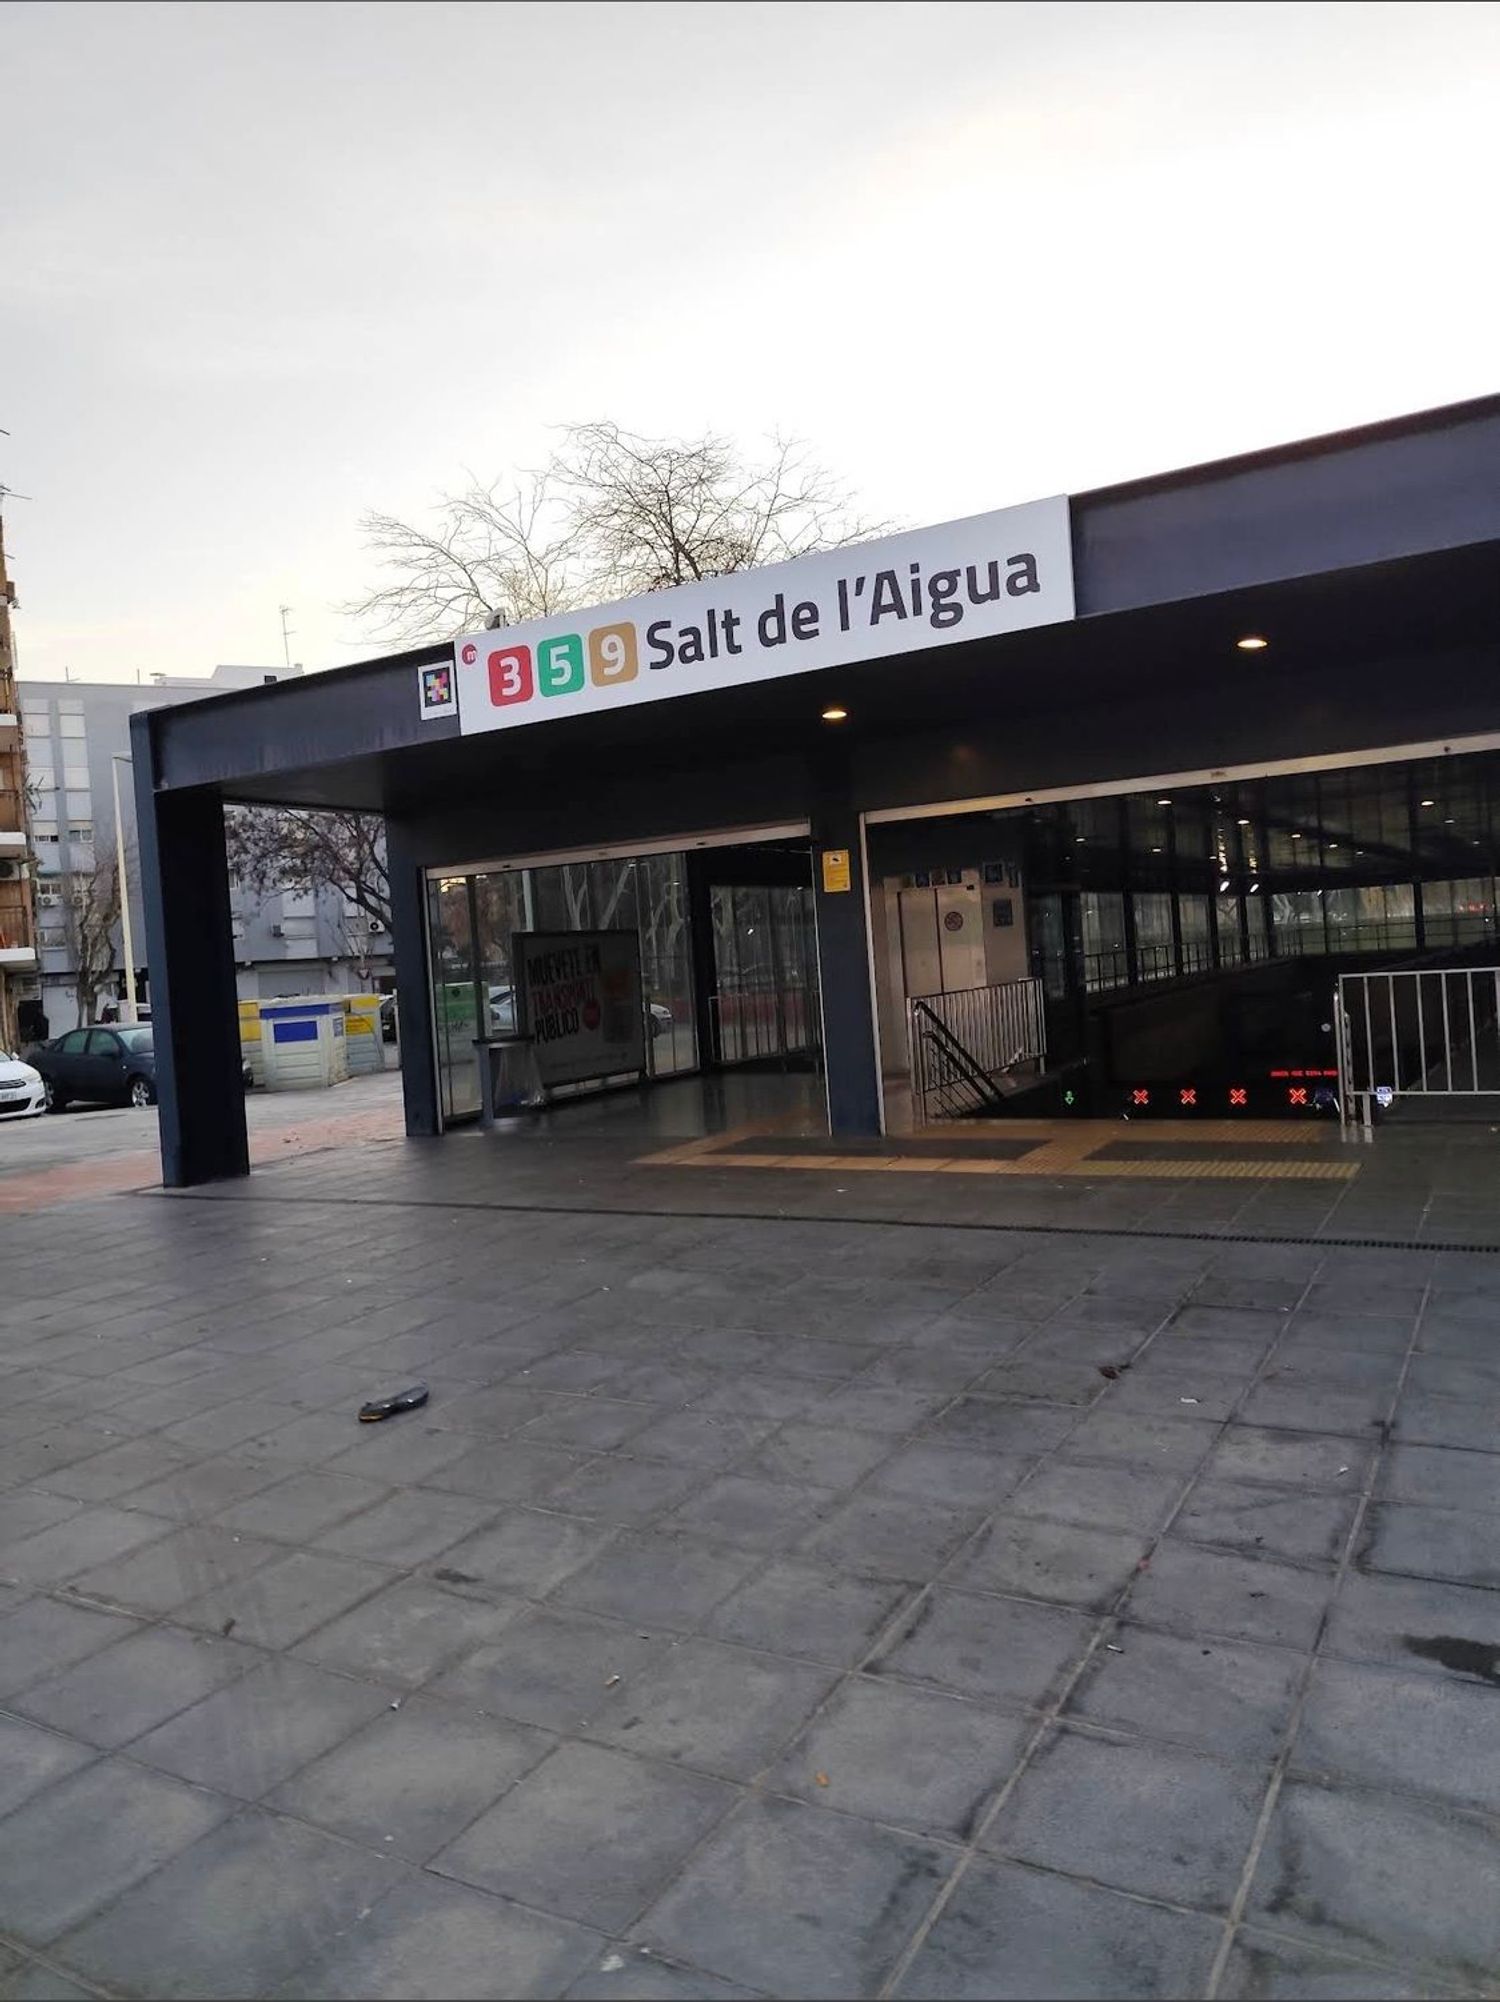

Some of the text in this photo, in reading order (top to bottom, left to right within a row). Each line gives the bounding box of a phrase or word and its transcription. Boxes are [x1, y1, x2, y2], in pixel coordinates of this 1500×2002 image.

[500, 553, 1040, 697] 3 5 9 Salt de l'Aigua
